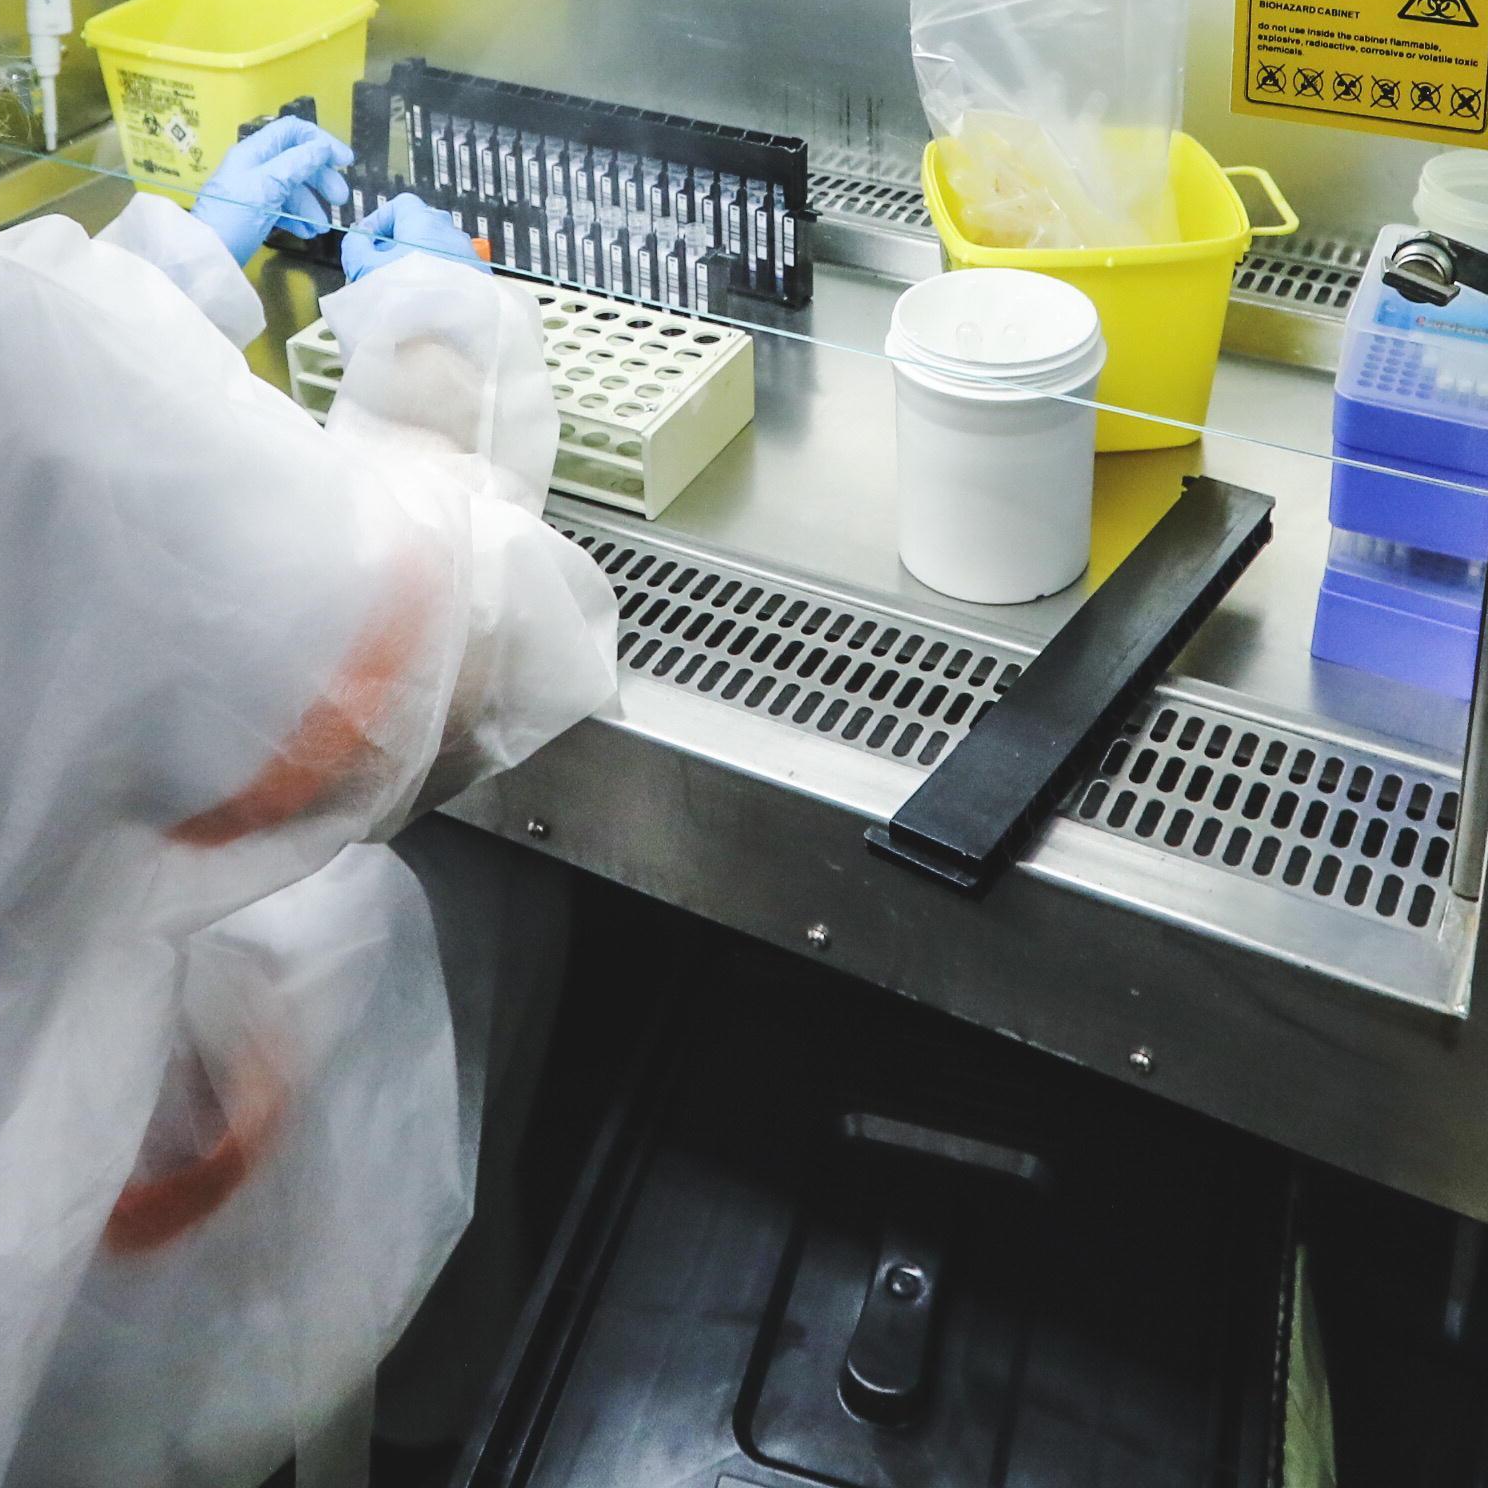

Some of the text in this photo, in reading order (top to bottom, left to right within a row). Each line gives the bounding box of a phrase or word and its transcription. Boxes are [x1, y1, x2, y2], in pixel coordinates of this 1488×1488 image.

[1259, 0, 1360, 20] BIOHAZARD CABINET
[1258, 22, 1270, 30] do
[1272, 24, 1287, 33] not
[1289, 26, 1306, 35] use
[1307, 27, 1335, 38] inside
[1337, 31, 1352, 41] the
[1354, 34, 1388, 45] cabinet
[1257, 32, 1479, 68] explosive, radioactive, corrosive or volatile toxic
